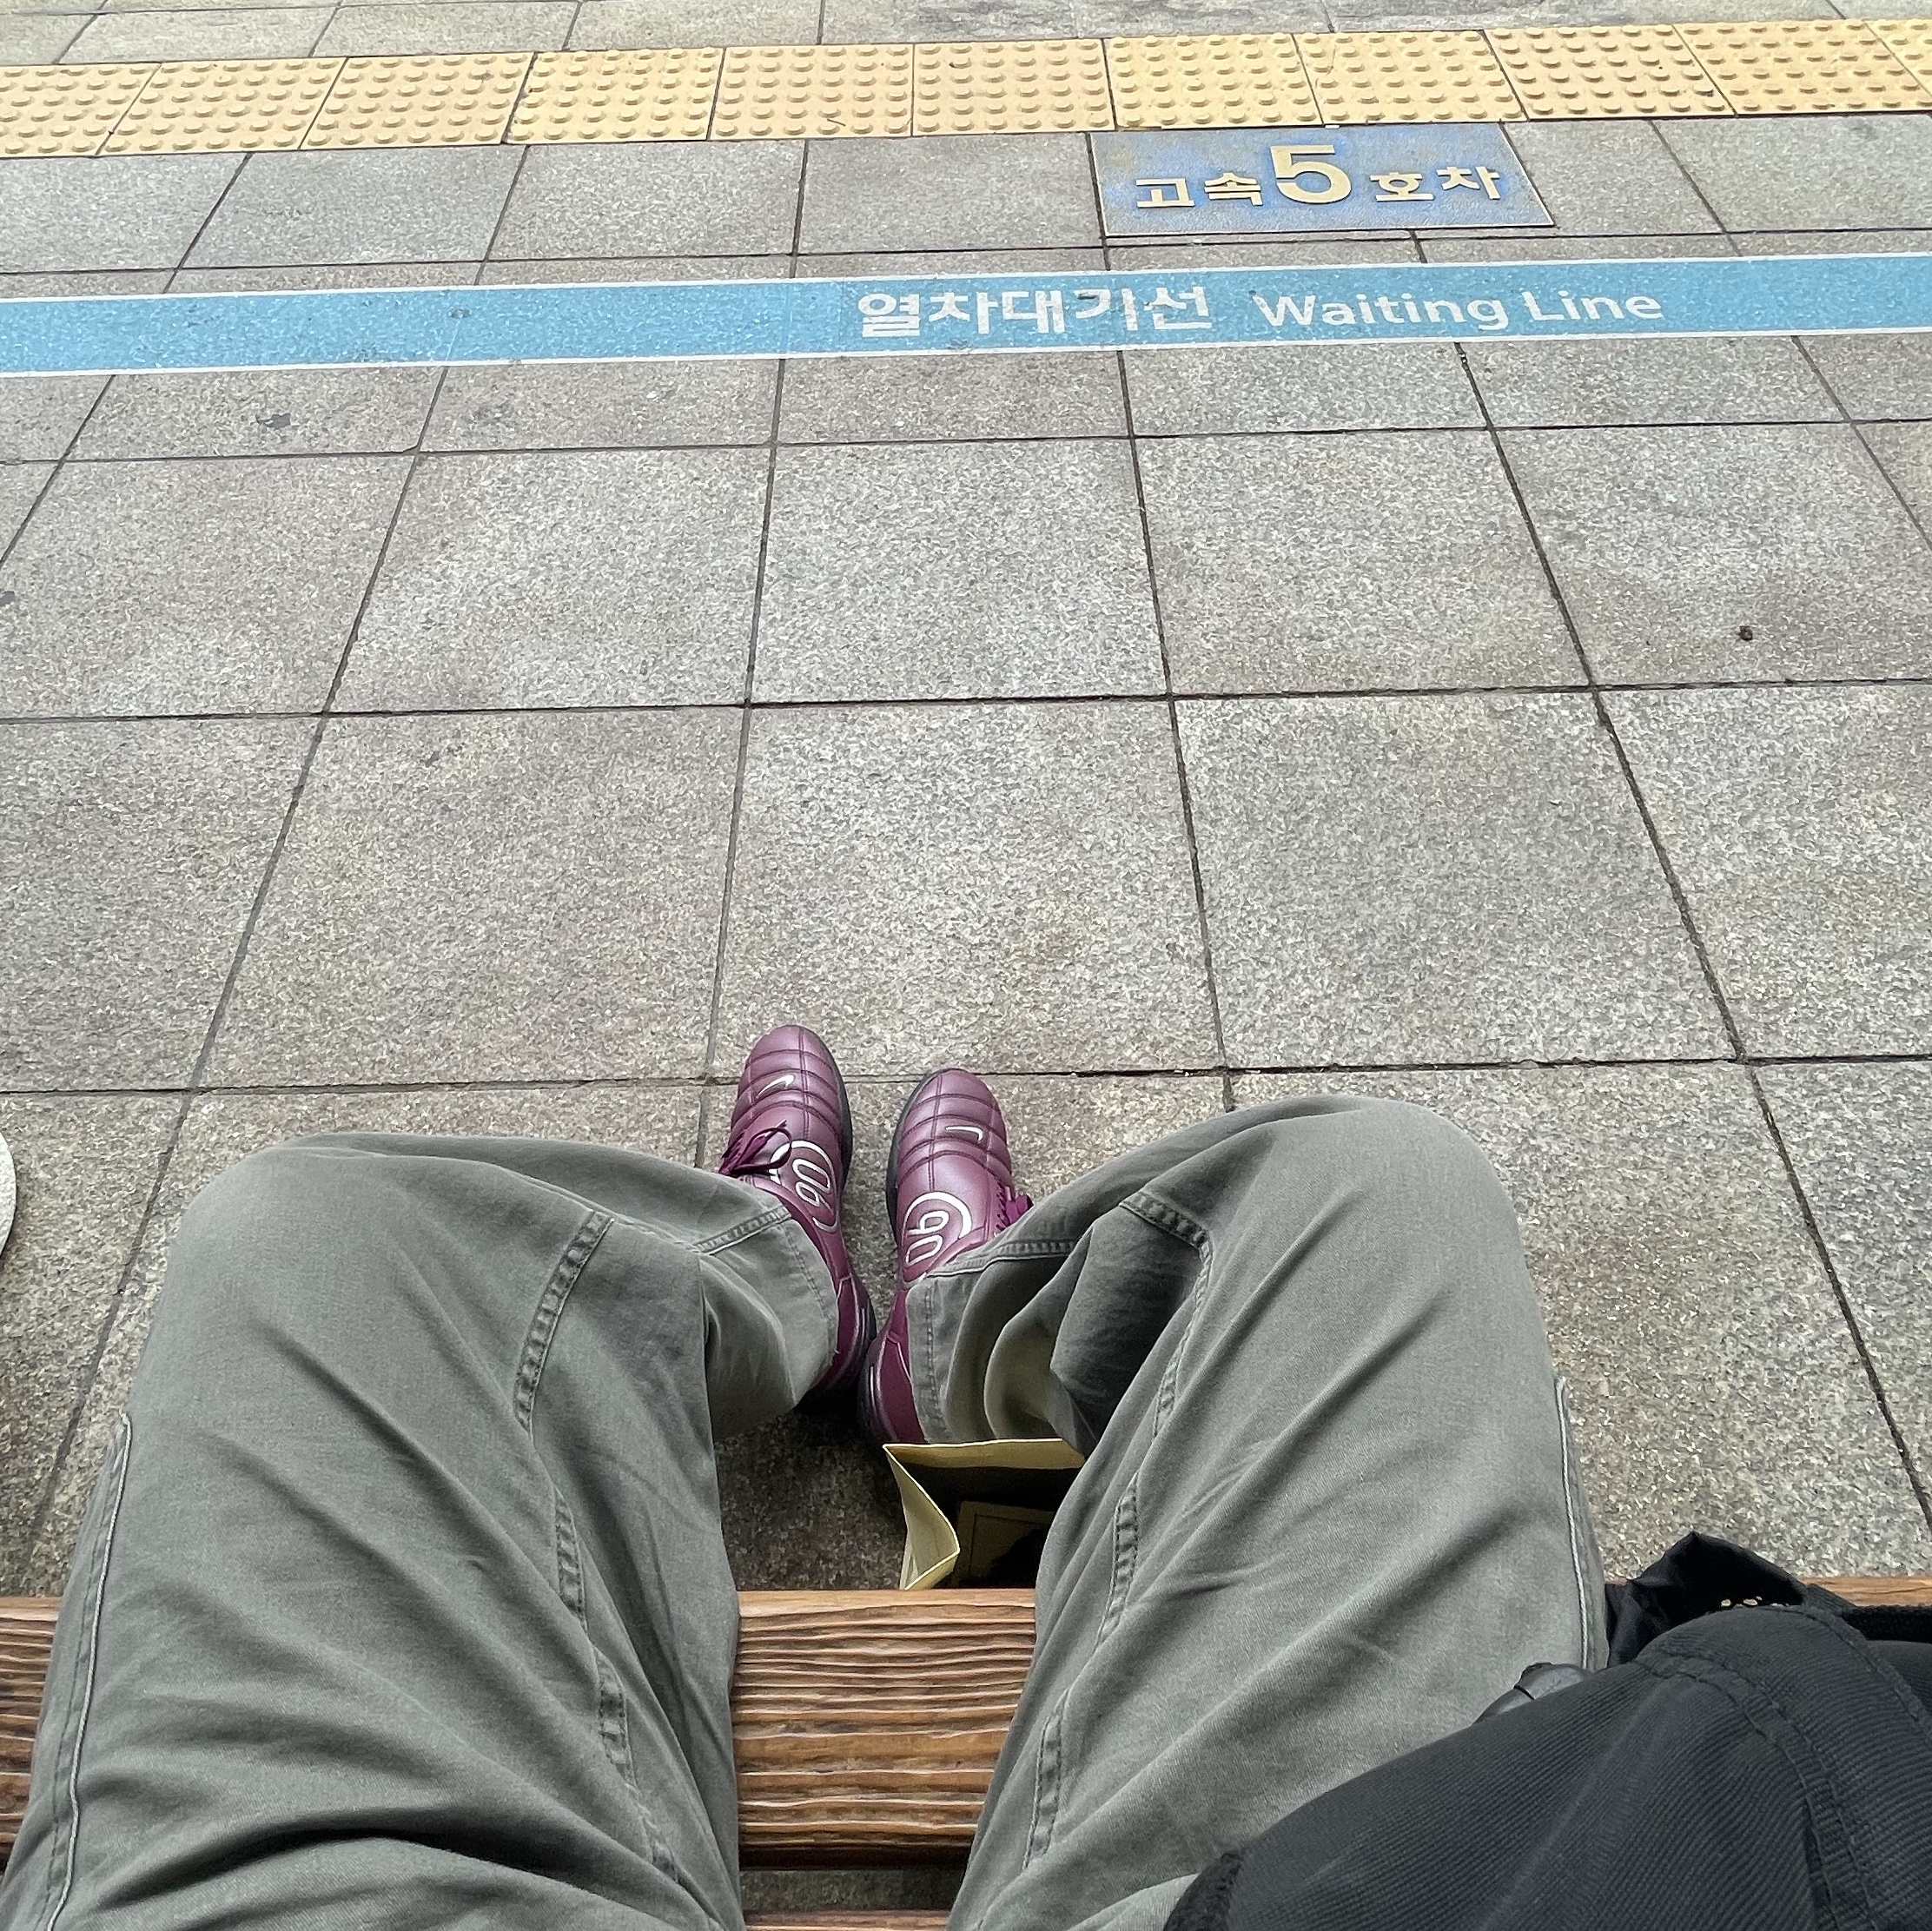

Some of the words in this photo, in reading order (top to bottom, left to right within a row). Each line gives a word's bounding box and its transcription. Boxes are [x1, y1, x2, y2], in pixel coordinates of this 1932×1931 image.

[857, 286, 1213, 338] 열차대기선
[1253, 293, 1510, 331] Waiting
[1521, 289, 1664, 321] Line
